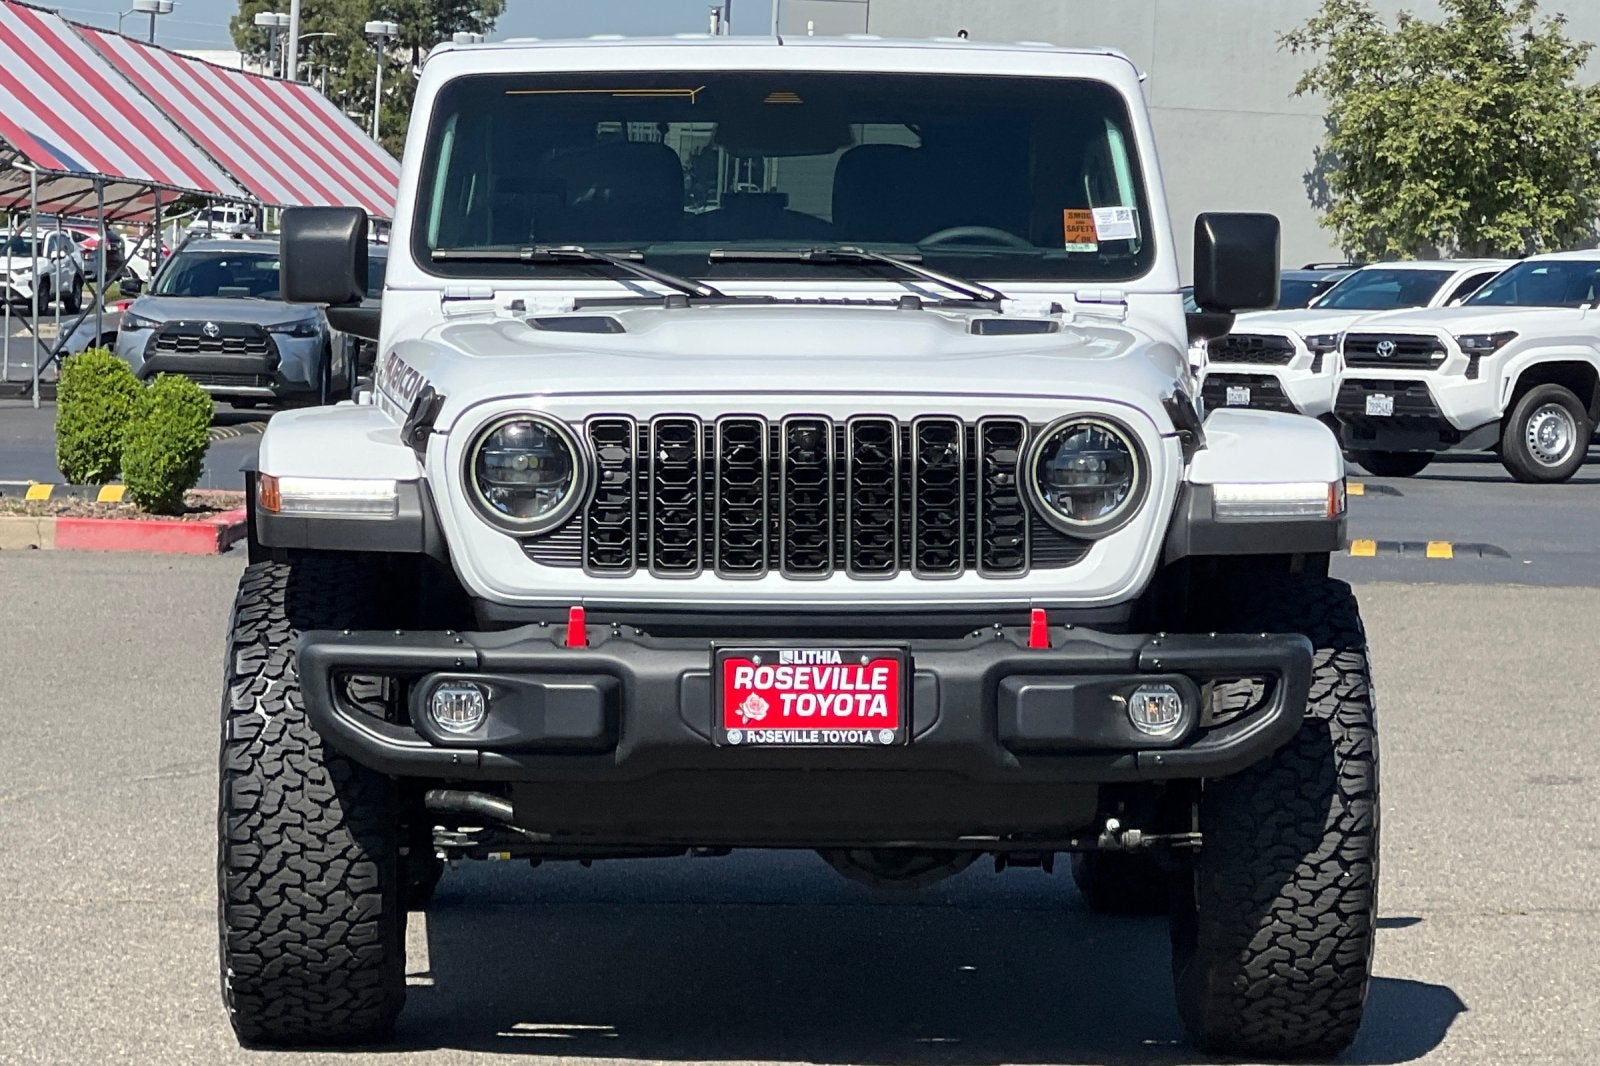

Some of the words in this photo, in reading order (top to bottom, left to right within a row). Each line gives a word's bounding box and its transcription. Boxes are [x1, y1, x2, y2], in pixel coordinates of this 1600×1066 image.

[793, 650, 842, 664] LITHIA
[734, 666, 888, 690] ROSEVILLE
[780, 693, 888, 717] TOYOTA
[747, 730, 819, 743] ROSEVILLE
[822, 730, 874, 743] TOYOTA
